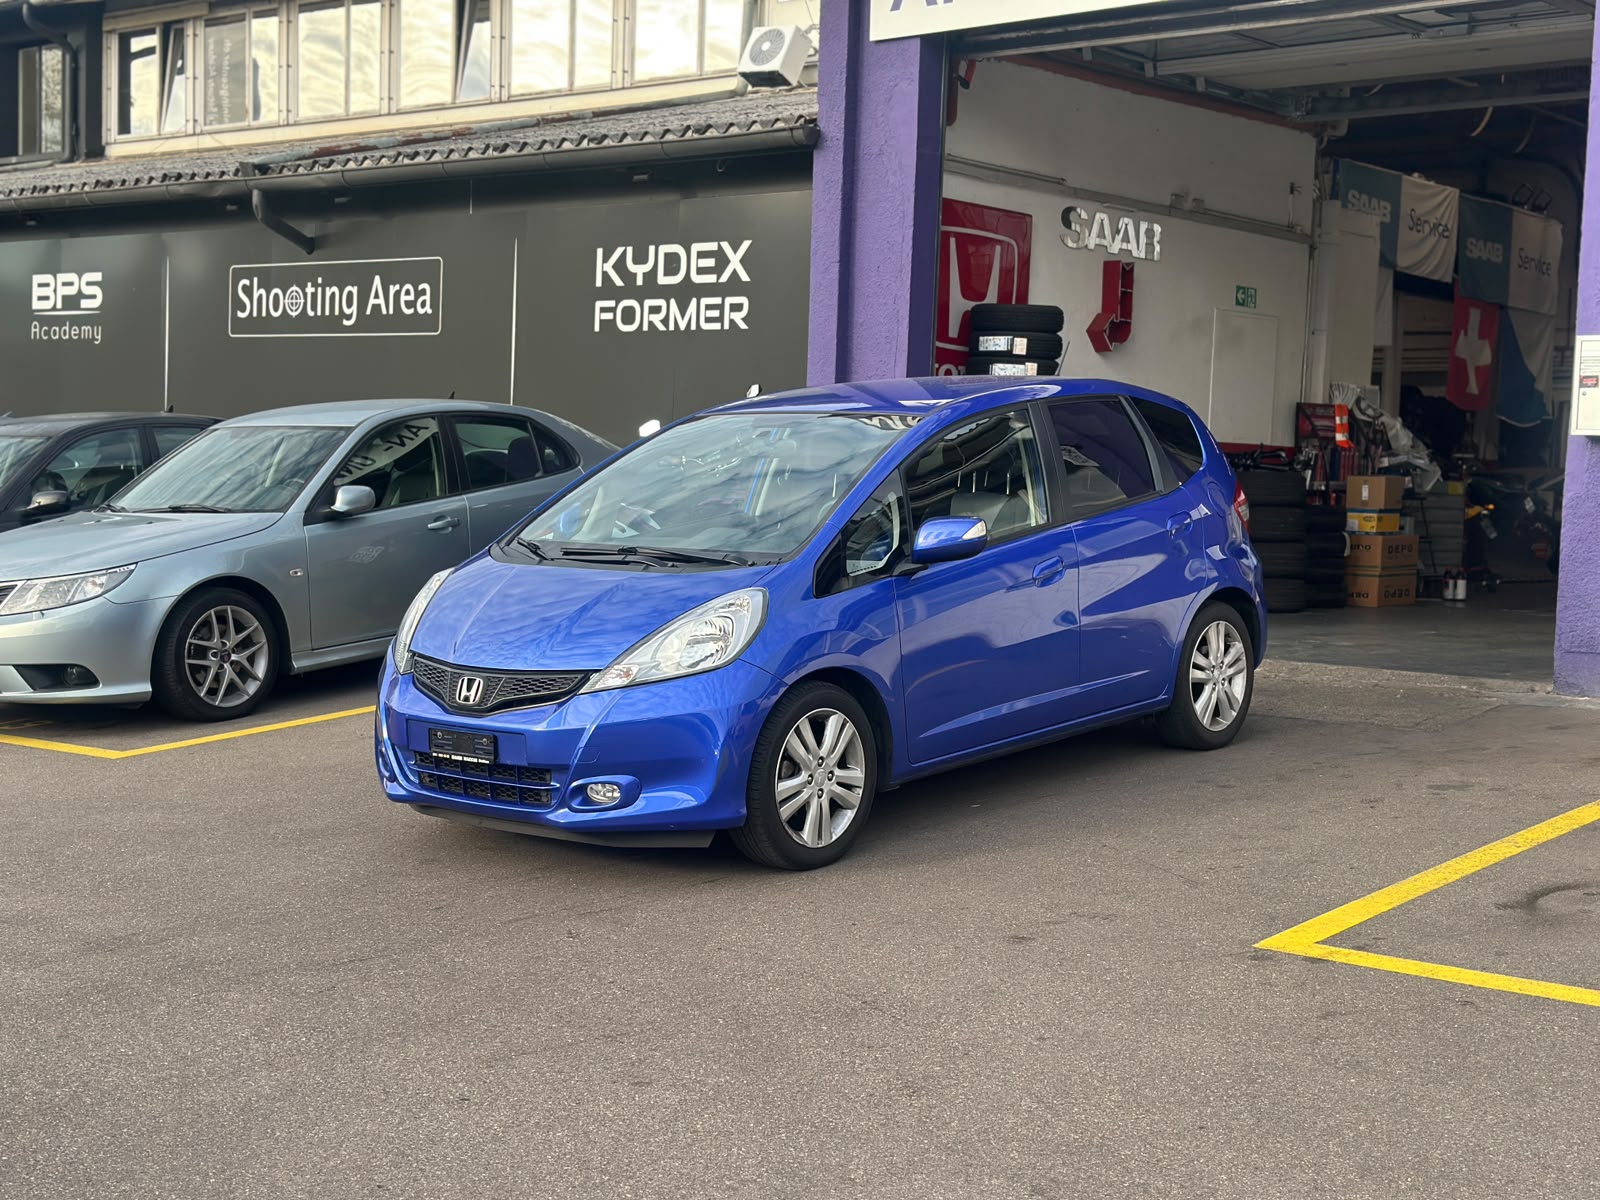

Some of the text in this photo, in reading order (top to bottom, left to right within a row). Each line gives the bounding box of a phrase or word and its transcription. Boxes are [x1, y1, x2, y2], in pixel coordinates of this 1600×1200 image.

[1347, 190, 1392, 224] SAAB
[1407, 208, 1450, 239] Service
[1060, 205, 1162, 261] SAAB
[595, 240, 752, 287] KYDEX
[1466, 238, 1503, 263] SAAB
[1518, 248, 1552, 277] Service
[32, 271, 103, 310] BPS
[236, 274, 433, 326] Shooting Area
[594, 296, 749, 332] FORMER
[31, 321, 102, 344] Academy
[1387, 543, 1414, 554] DEPO
